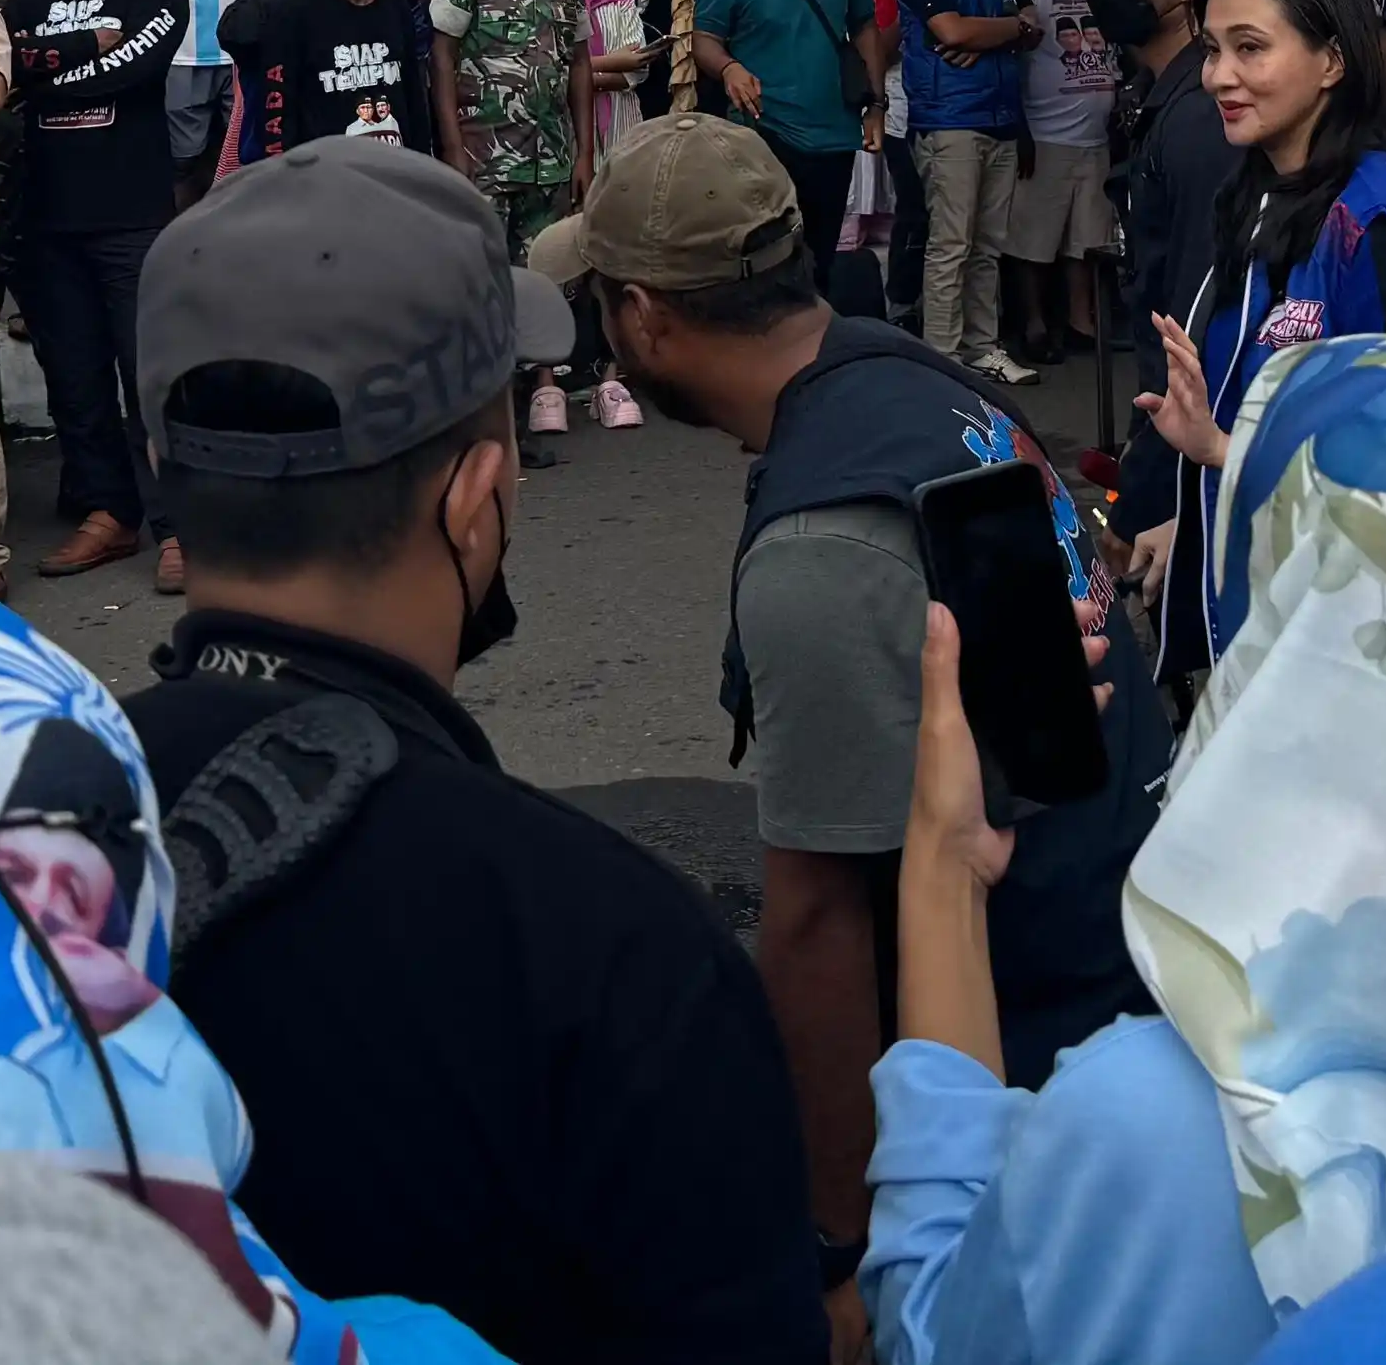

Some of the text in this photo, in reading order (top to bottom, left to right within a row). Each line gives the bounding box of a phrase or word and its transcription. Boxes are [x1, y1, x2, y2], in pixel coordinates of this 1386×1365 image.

[99, 8, 176, 72] PILIHAN
[333, 42, 389, 68] SIAP
[318, 61, 402, 93] TEMPU
[197, 644, 290, 682] ONY
